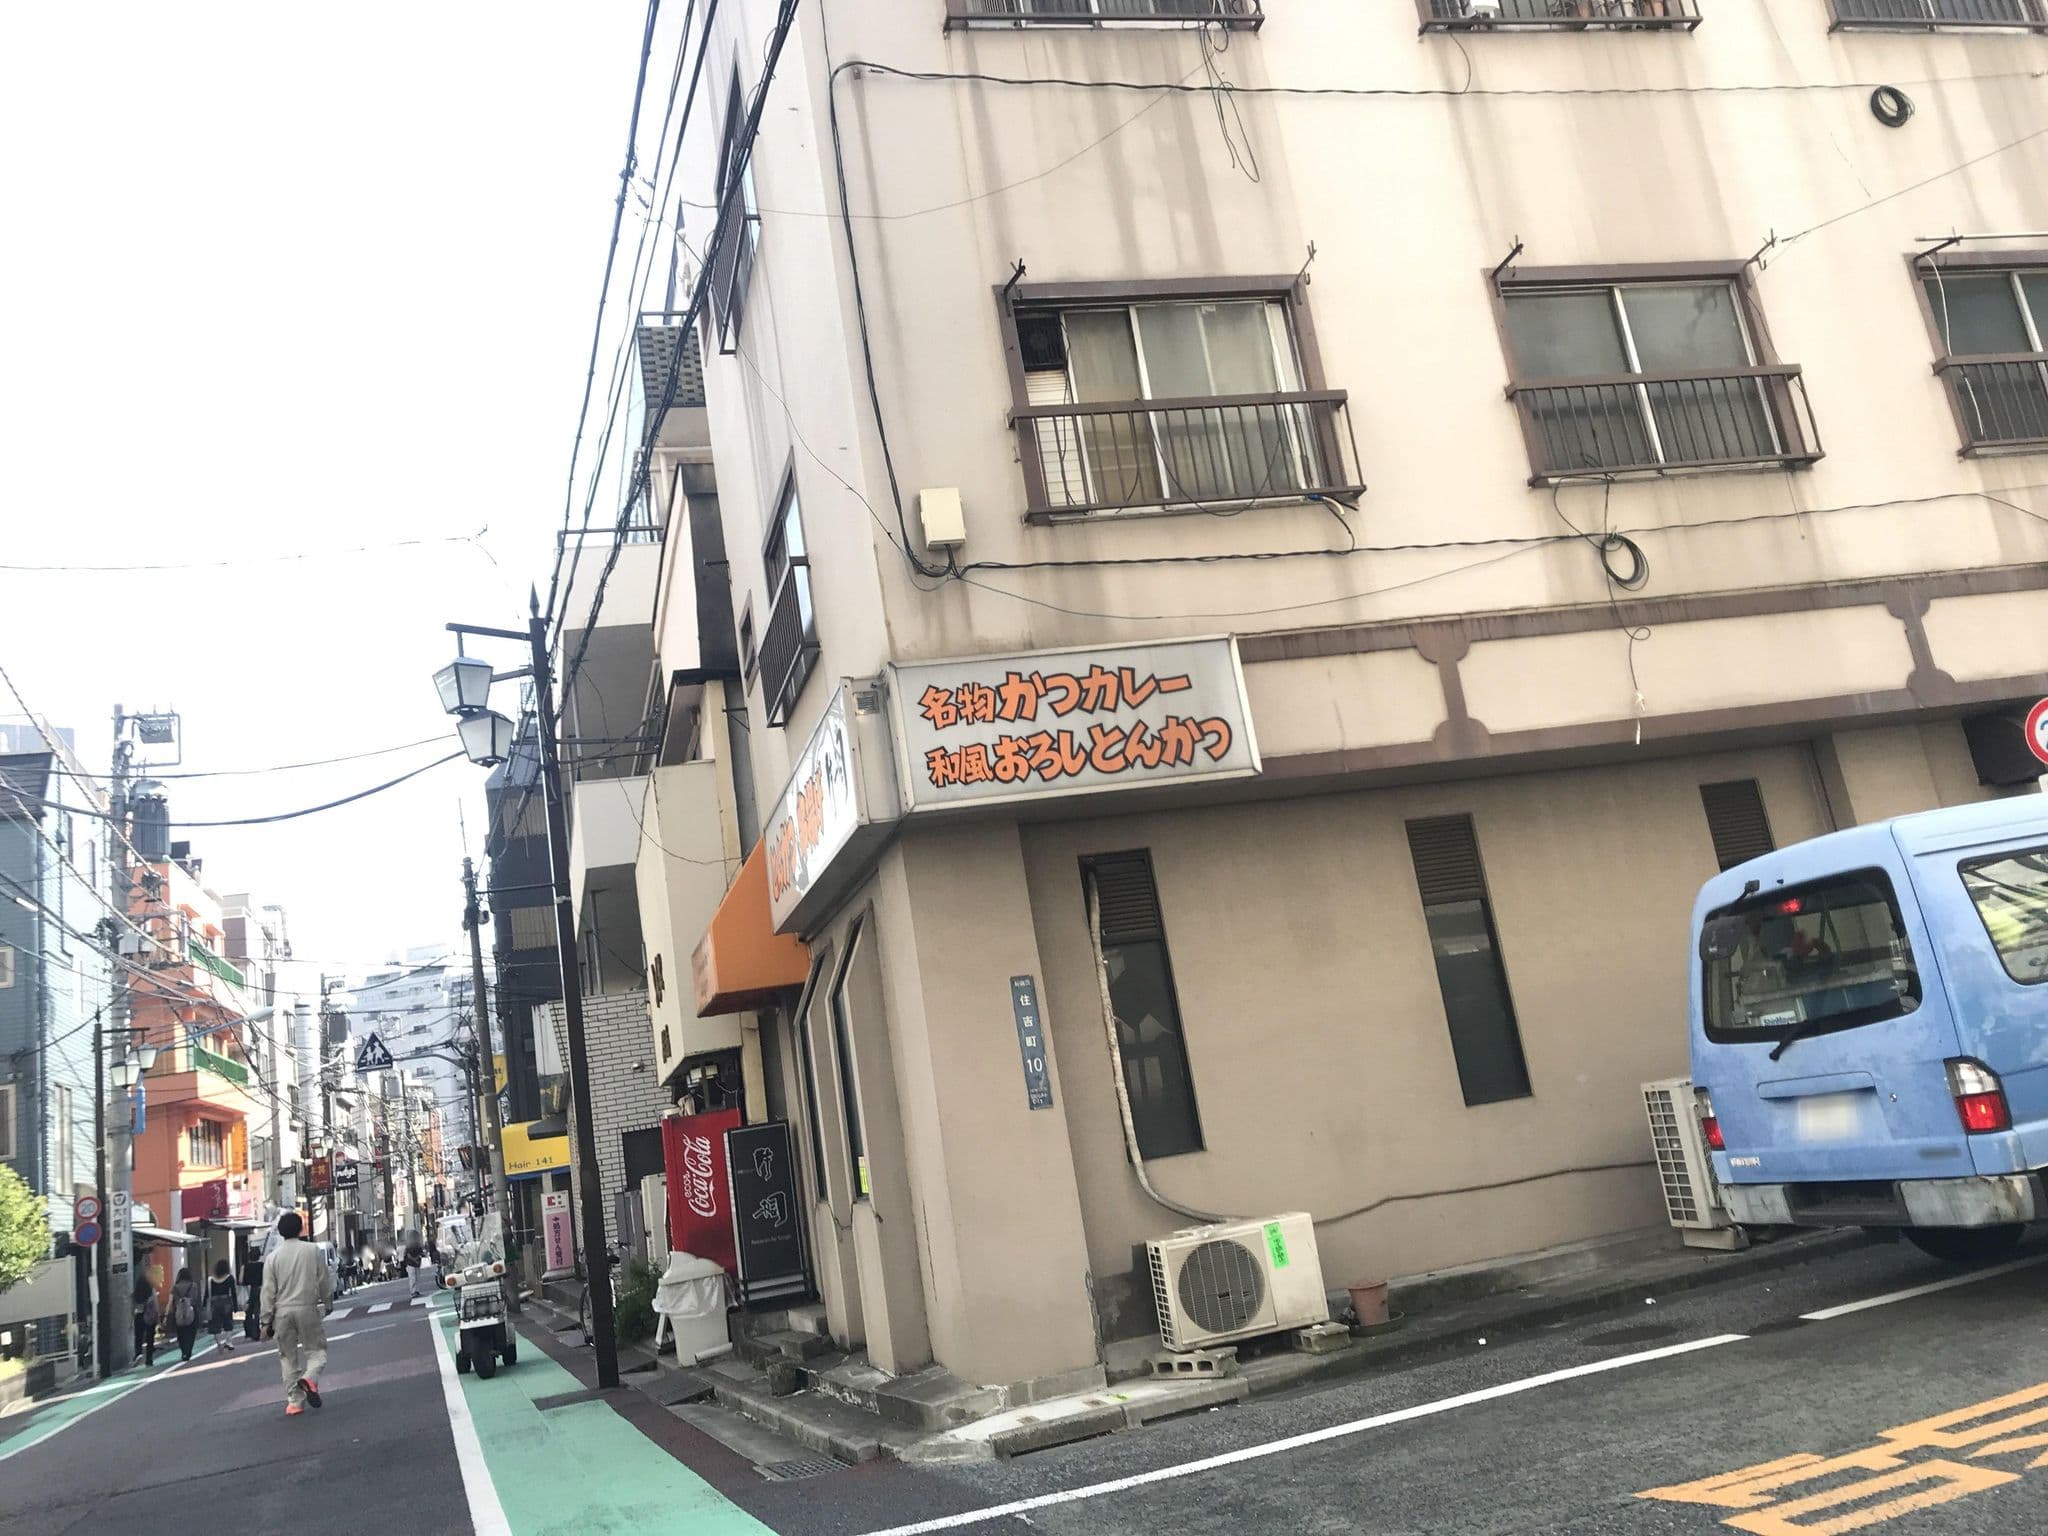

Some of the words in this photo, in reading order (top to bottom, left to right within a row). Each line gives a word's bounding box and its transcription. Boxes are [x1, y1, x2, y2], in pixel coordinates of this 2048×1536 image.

[917, 663, 1192, 731] 名物かつカレー
[925, 714, 1233, 788] 和風おろしとんかつ
[1019, 993, 1037, 1048] 住吉町
[1026, 1057, 1043, 1073] 10
[508, 1160, 531, 1170] Hair
[536, 1156, 554, 1166] 141
[683, 1133, 717, 1217] Coca-Cola
